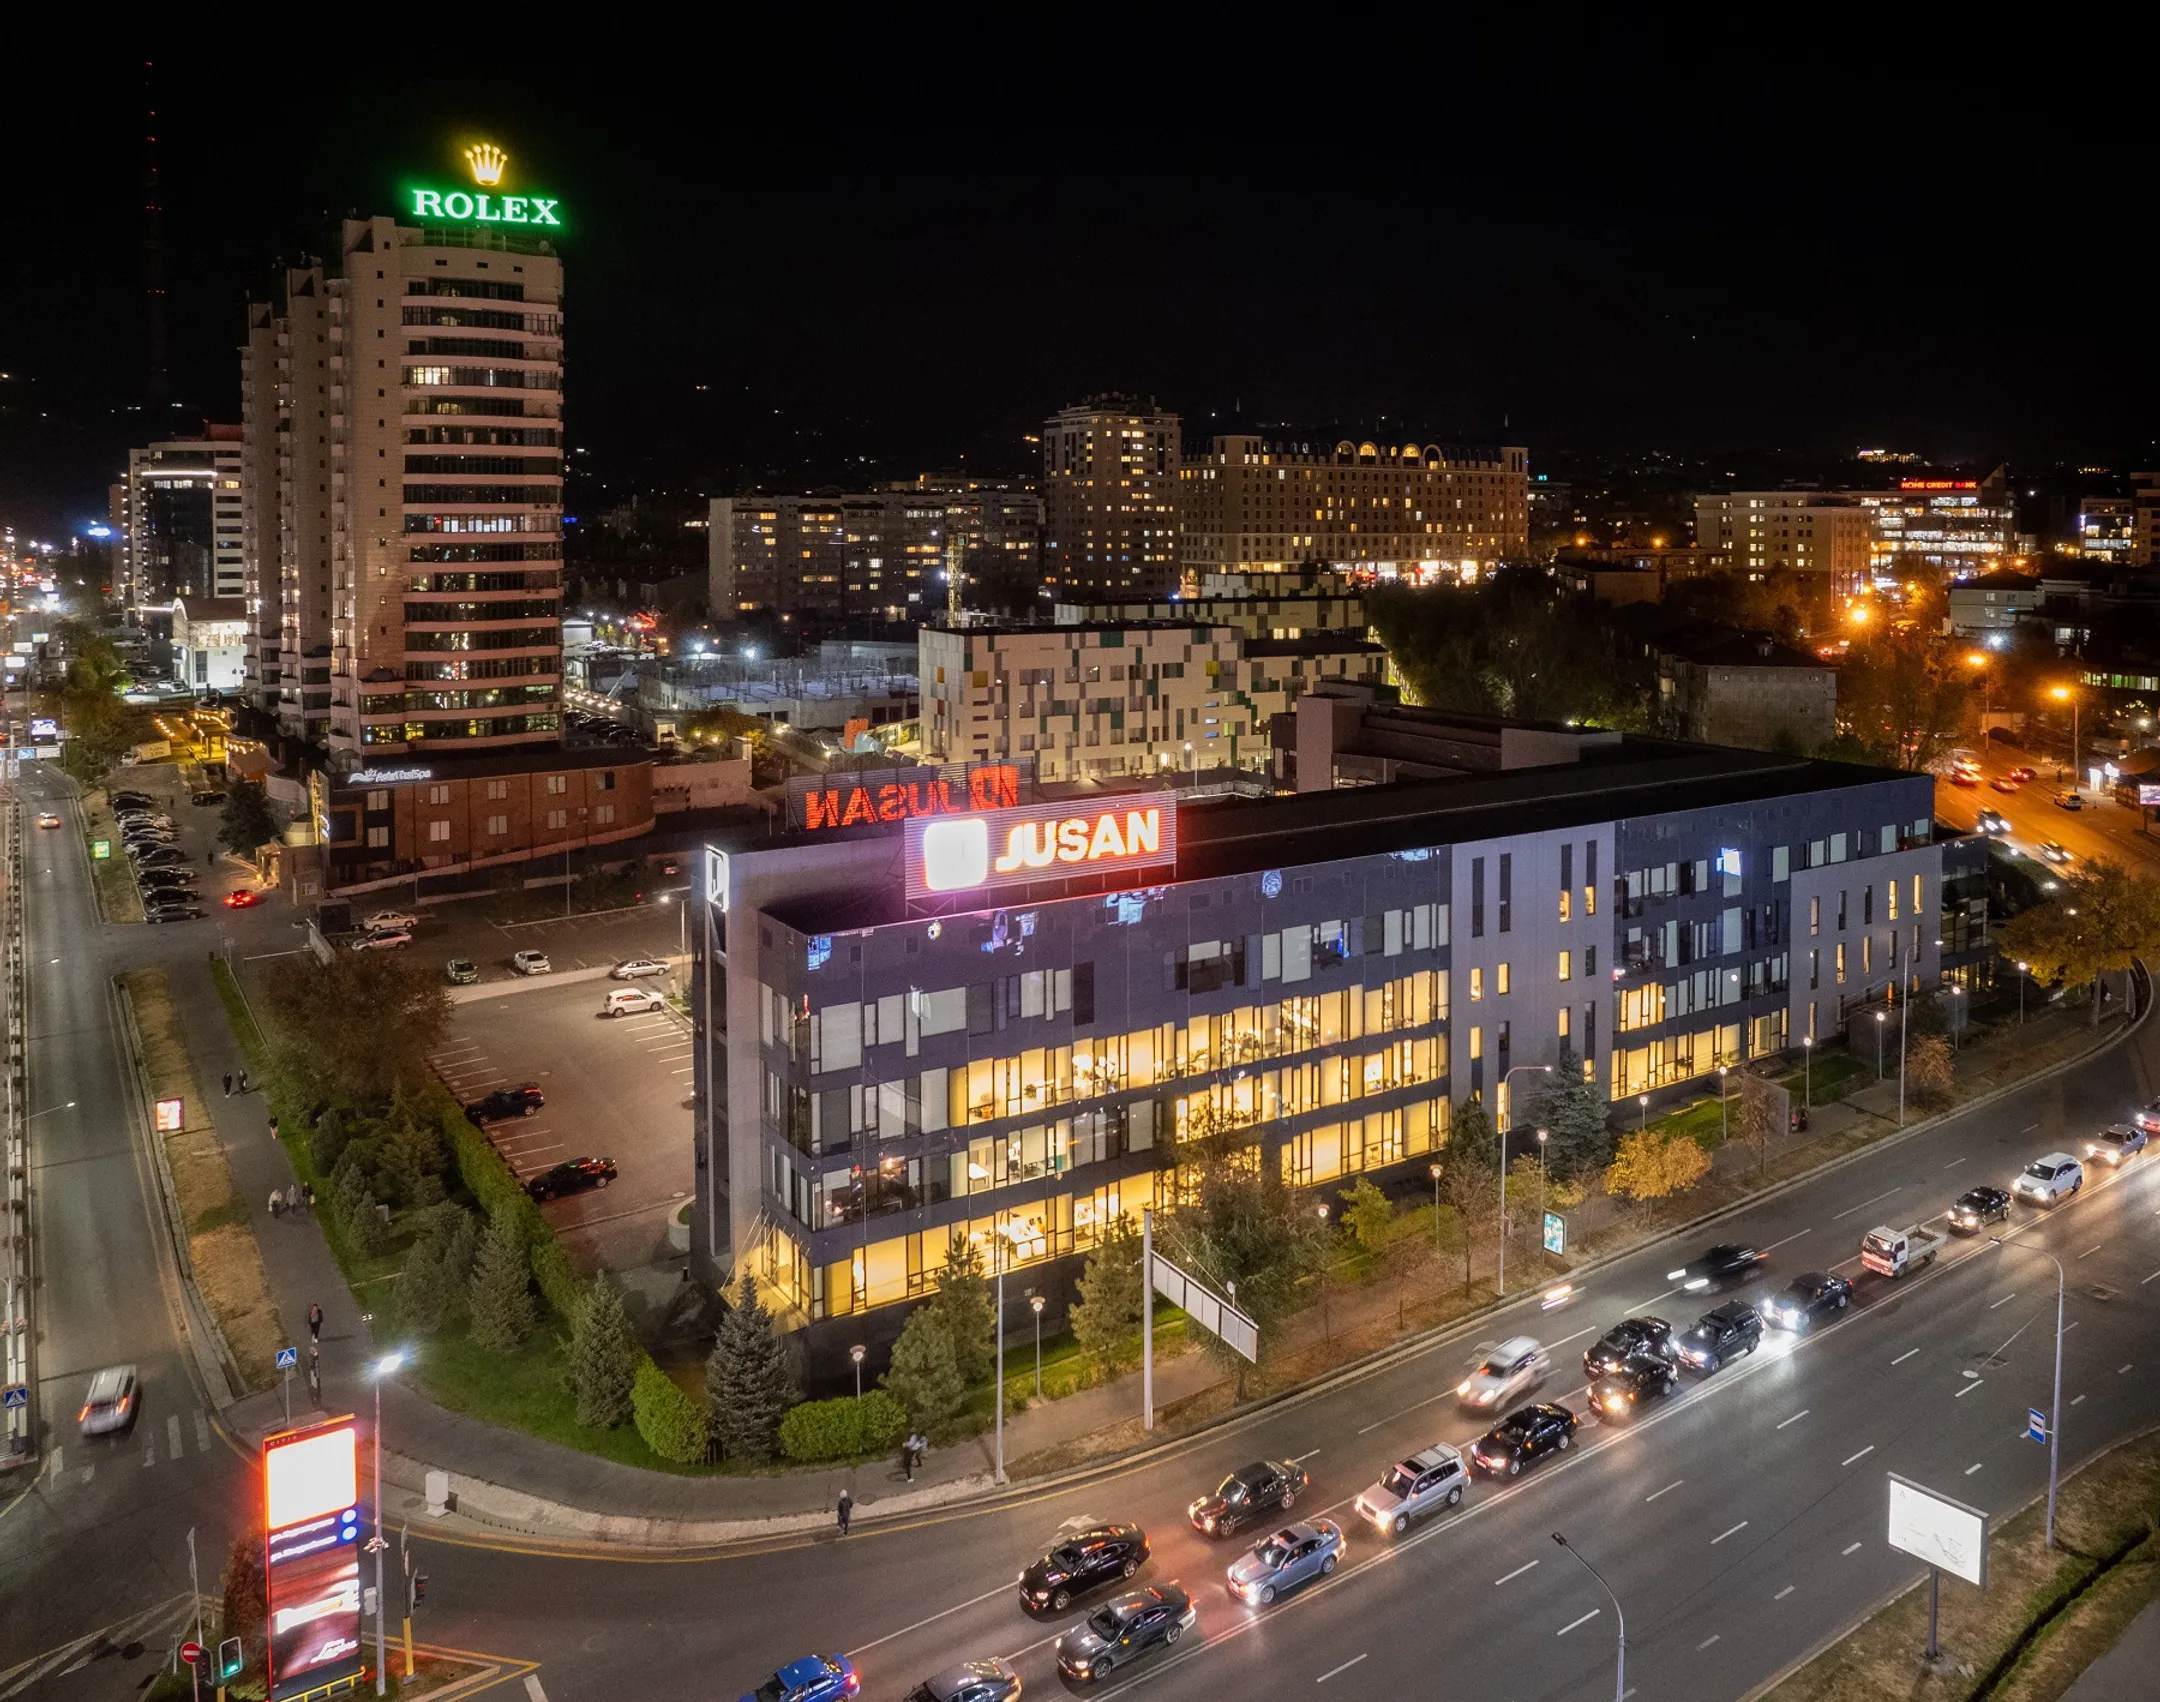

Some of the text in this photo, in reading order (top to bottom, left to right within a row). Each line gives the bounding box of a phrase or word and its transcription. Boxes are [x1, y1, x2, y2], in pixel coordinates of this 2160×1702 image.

[412, 189, 561, 225] ROLEX
[1901, 481, 1925, 489] HOME
[1926, 481, 1953, 489] CREDIT
[995, 809, 1160, 873] JUSAN
